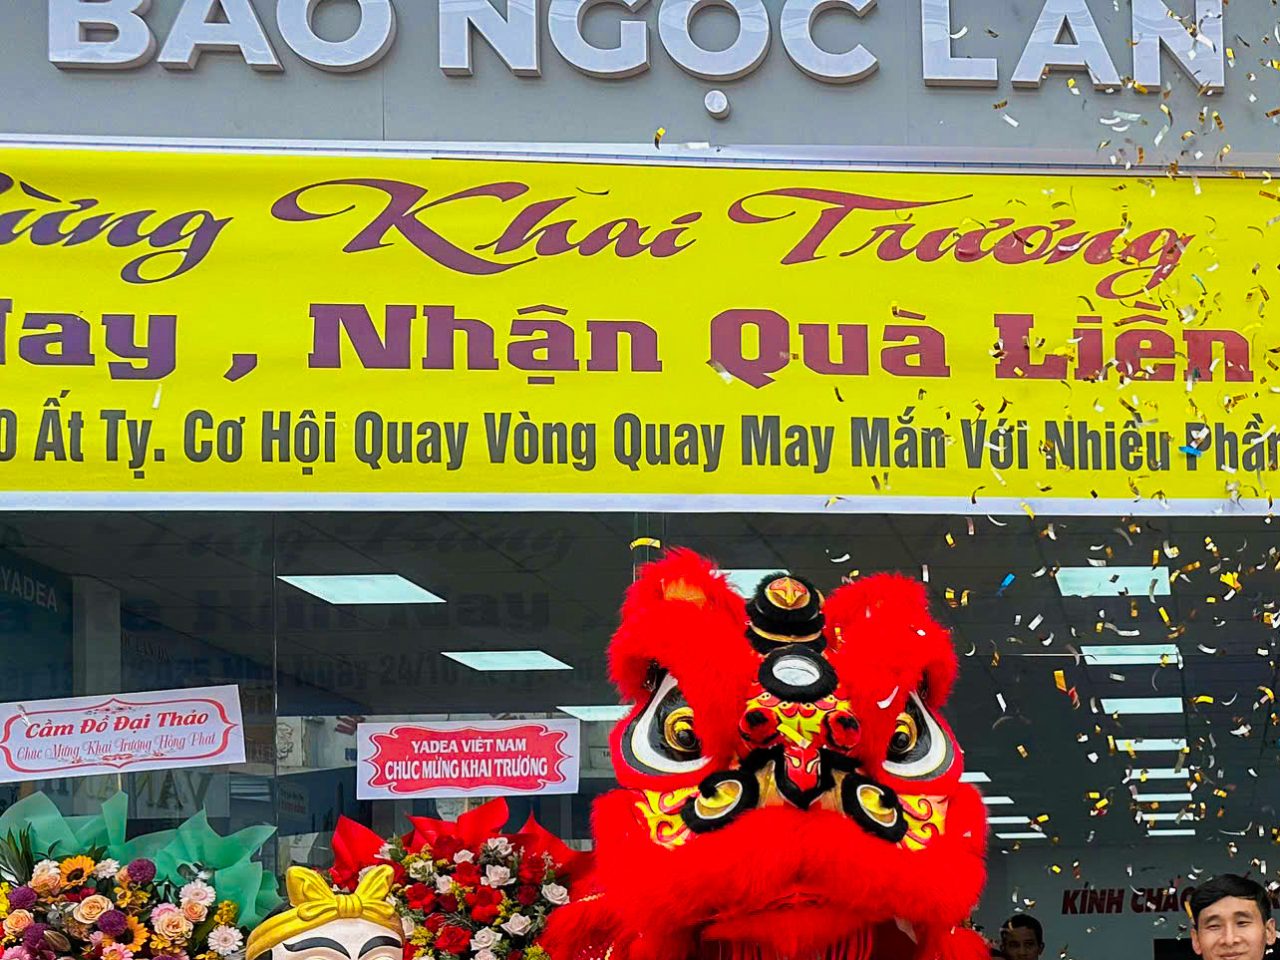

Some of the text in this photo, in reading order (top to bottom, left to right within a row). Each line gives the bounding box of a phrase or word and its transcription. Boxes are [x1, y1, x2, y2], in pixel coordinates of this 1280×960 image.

[438, 0, 879, 118] NGỌC
[921, 0, 1226, 94] LAN
[271, 178, 703, 275] Khai
[728, 187, 1196, 299] Trương
[307, 303, 663, 385] Nhận
[706, 307, 951, 389] Quà
[993, 301, 1255, 382] Liền
[34, 389, 85, 463] Ất
[100, 409, 165, 479] Tỵ.
[184, 409, 246, 463] Cơ
[261, 409, 336, 475] Hội
[355, 410, 469, 471] Quay
[484, 411, 597, 471] Vòng
[614, 412, 725, 473] Quay
[741, 414, 835, 474] May
[850, 406, 946, 469] Mắn
[960, 417, 1029, 470] Với
[1044, 412, 1170, 471] Nhiều
[25, 708, 209, 739] Cầm Đồ Đại Thảo
[84, 739, 113, 756] Khai
[411, 736, 527, 755] YADEA VIỆT NAM
[384, 755, 548, 780] CHÚC MỪNG KHAI TRƯƠNG
[1061, 881, 1126, 915] KÍNH
